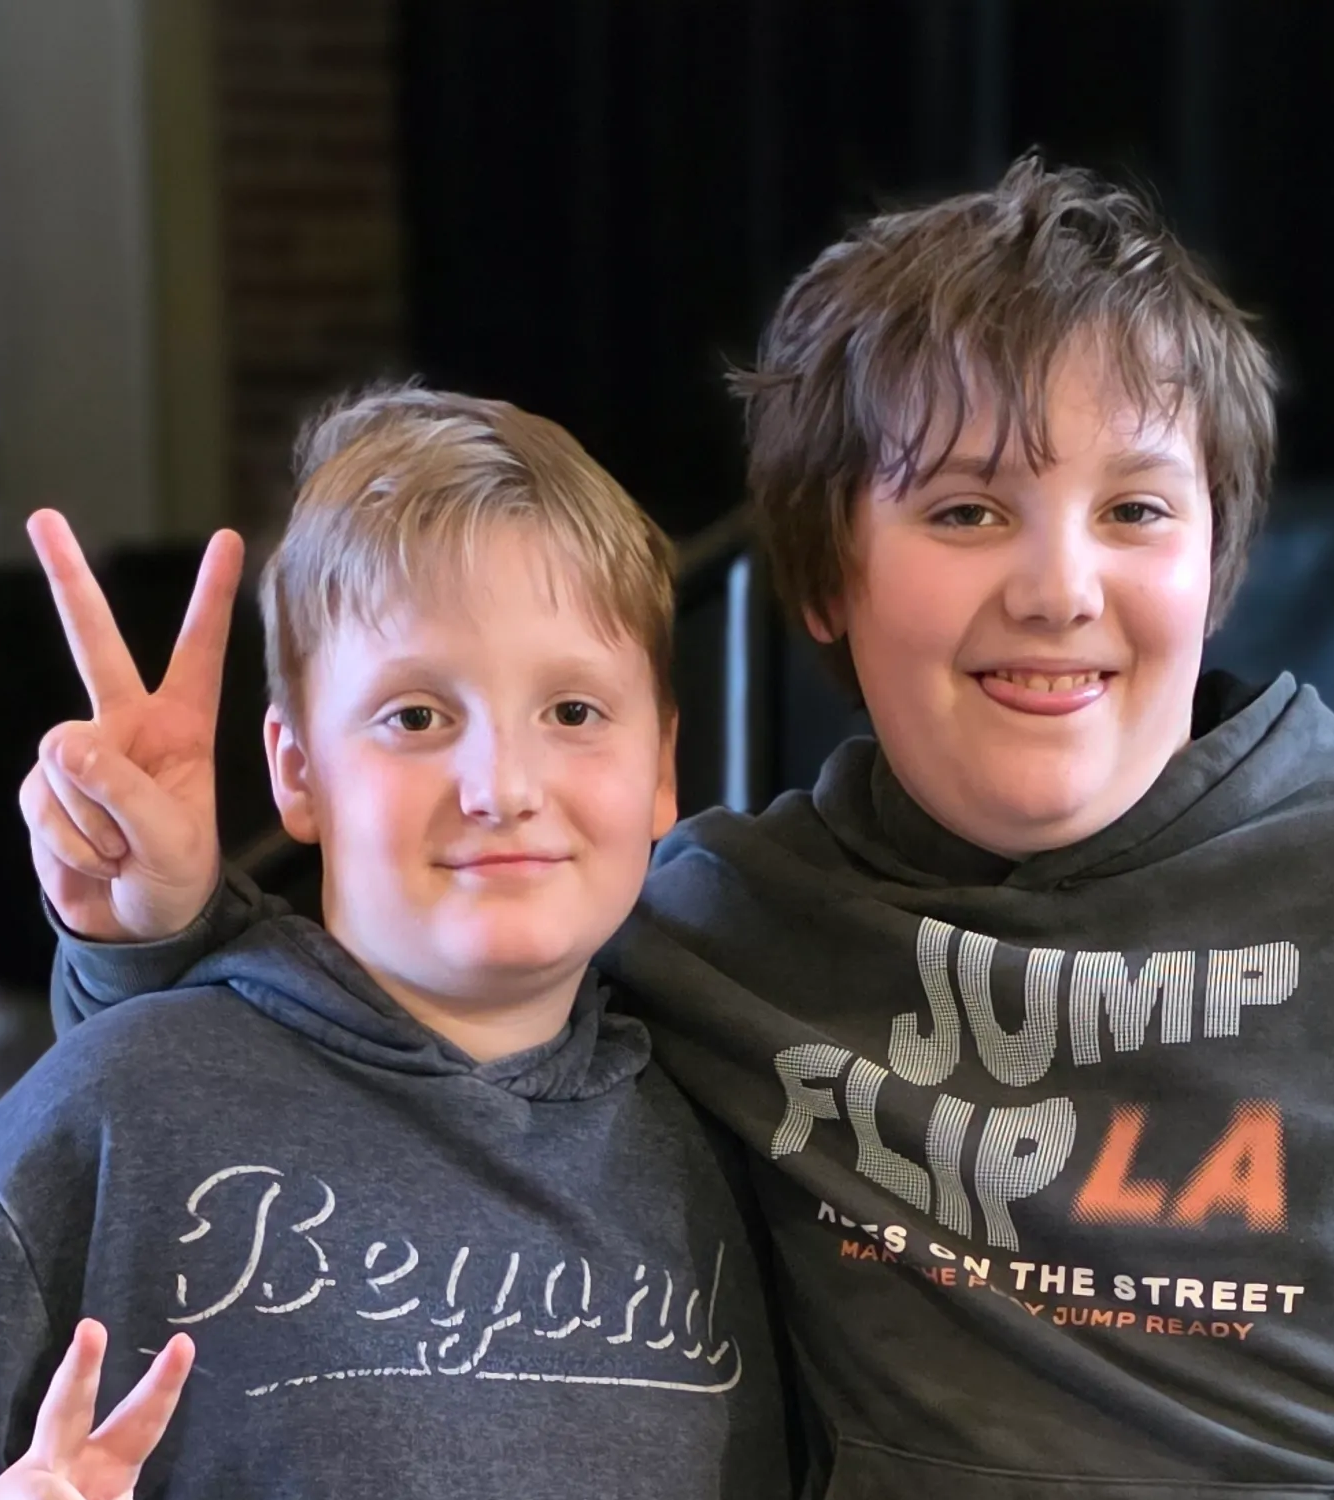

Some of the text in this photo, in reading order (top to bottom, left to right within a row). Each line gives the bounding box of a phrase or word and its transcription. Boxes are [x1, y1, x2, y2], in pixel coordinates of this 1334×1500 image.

[888, 916, 1299, 1087] JUMP
[771, 1044, 1287, 1252] FLIP LA
[929, 1243, 990, 1279] ON
[1010, 1262, 1095, 1297] THE
[1114, 1275, 1305, 1314] STREET
[1052, 1306, 1136, 1329] JUMP
[1146, 1315, 1255, 1341] READY
